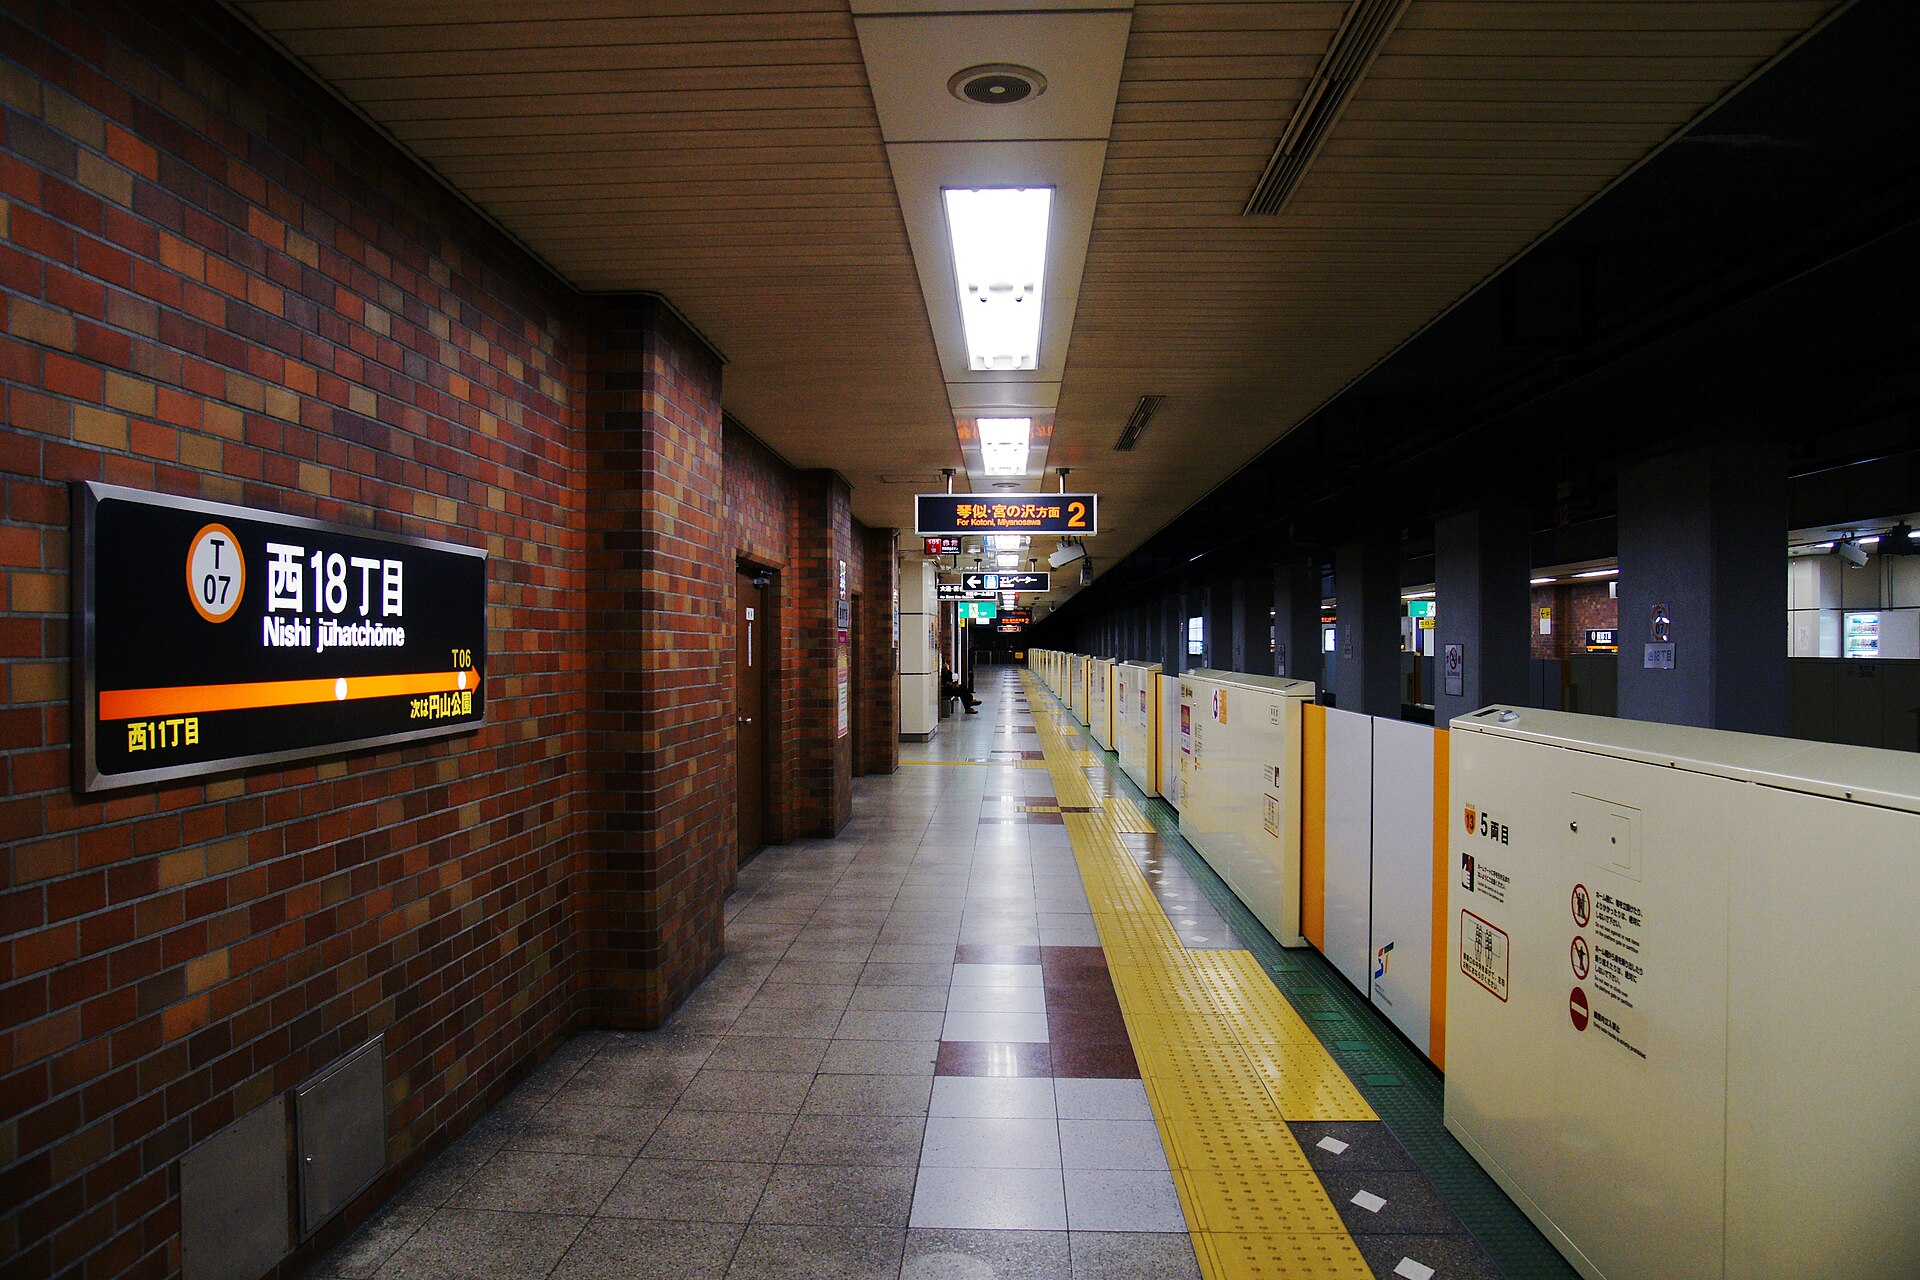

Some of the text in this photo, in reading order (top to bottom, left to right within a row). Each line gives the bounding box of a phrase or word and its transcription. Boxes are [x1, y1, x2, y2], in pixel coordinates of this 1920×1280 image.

[956, 504, 1060, 519] 琴似・宮の沢方面
[970, 518, 996, 527] Kotoni,
[997, 519, 1042, 527] Miyanosawa
[1068, 502, 1086, 526] 2
[210, 539, 225, 570] T
[203, 574, 231, 605] 07
[266, 542, 403, 617] 西18丁目
[263, 616, 405, 654] Nishi jūhatchōme
[127, 717, 199, 752] 西11丁目
[1480, 812, 1509, 846] 5両目
